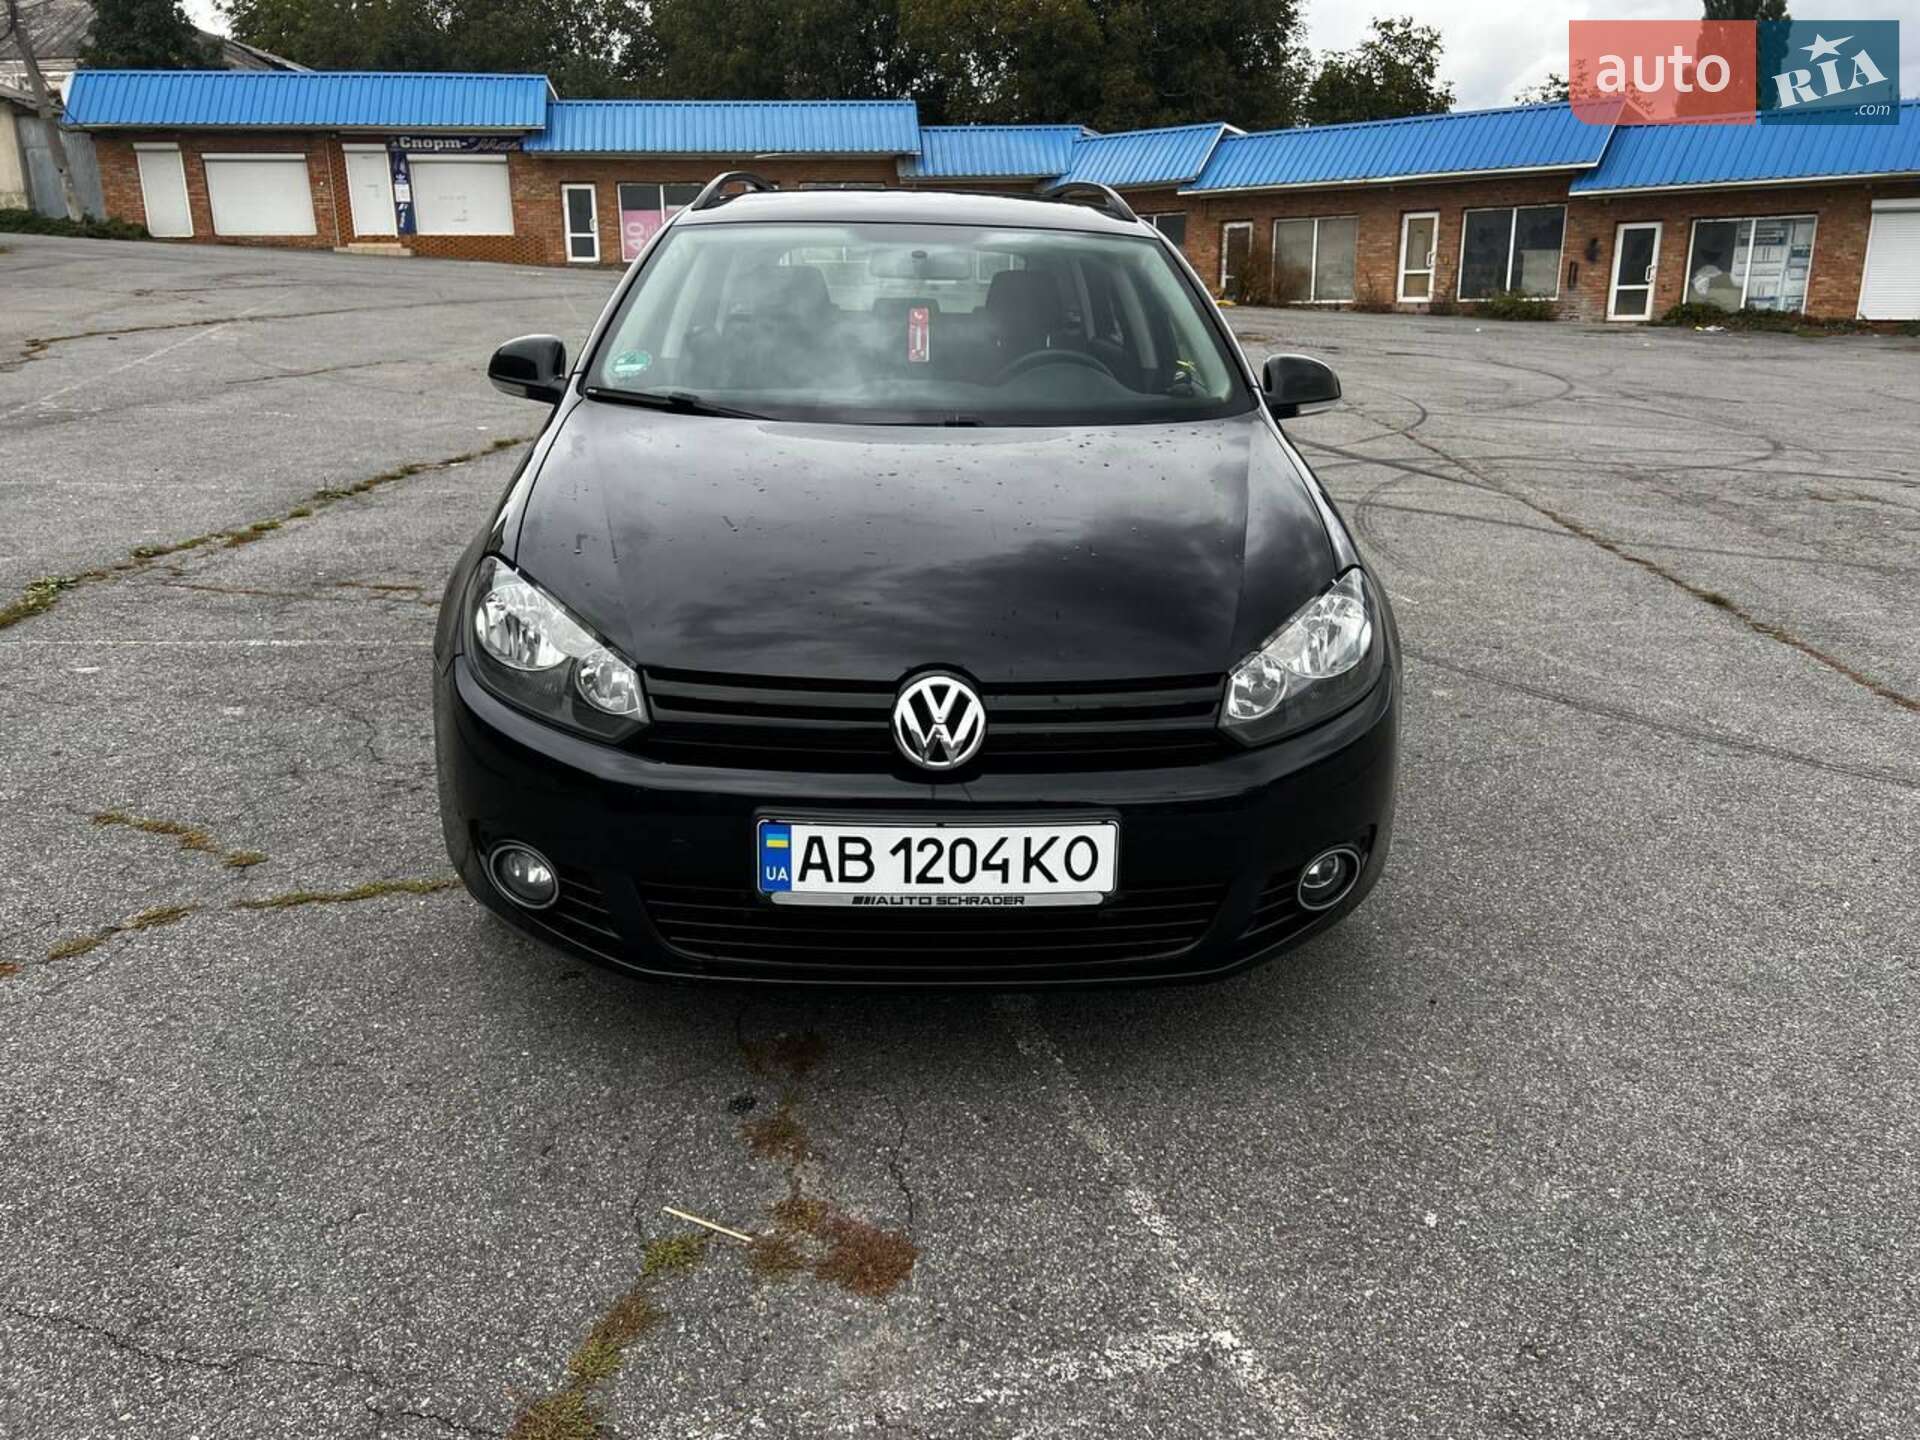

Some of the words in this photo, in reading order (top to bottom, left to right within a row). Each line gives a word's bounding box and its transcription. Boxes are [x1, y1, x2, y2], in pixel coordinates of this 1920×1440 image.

[797, 836, 875, 884] AB
[889, 836, 1009, 885] 1204
[1023, 836, 1099, 883] KO
[766, 867, 788, 881] UA
[876, 895, 932, 905] AUTO
[935, 895, 1025, 906] SCHRADER
